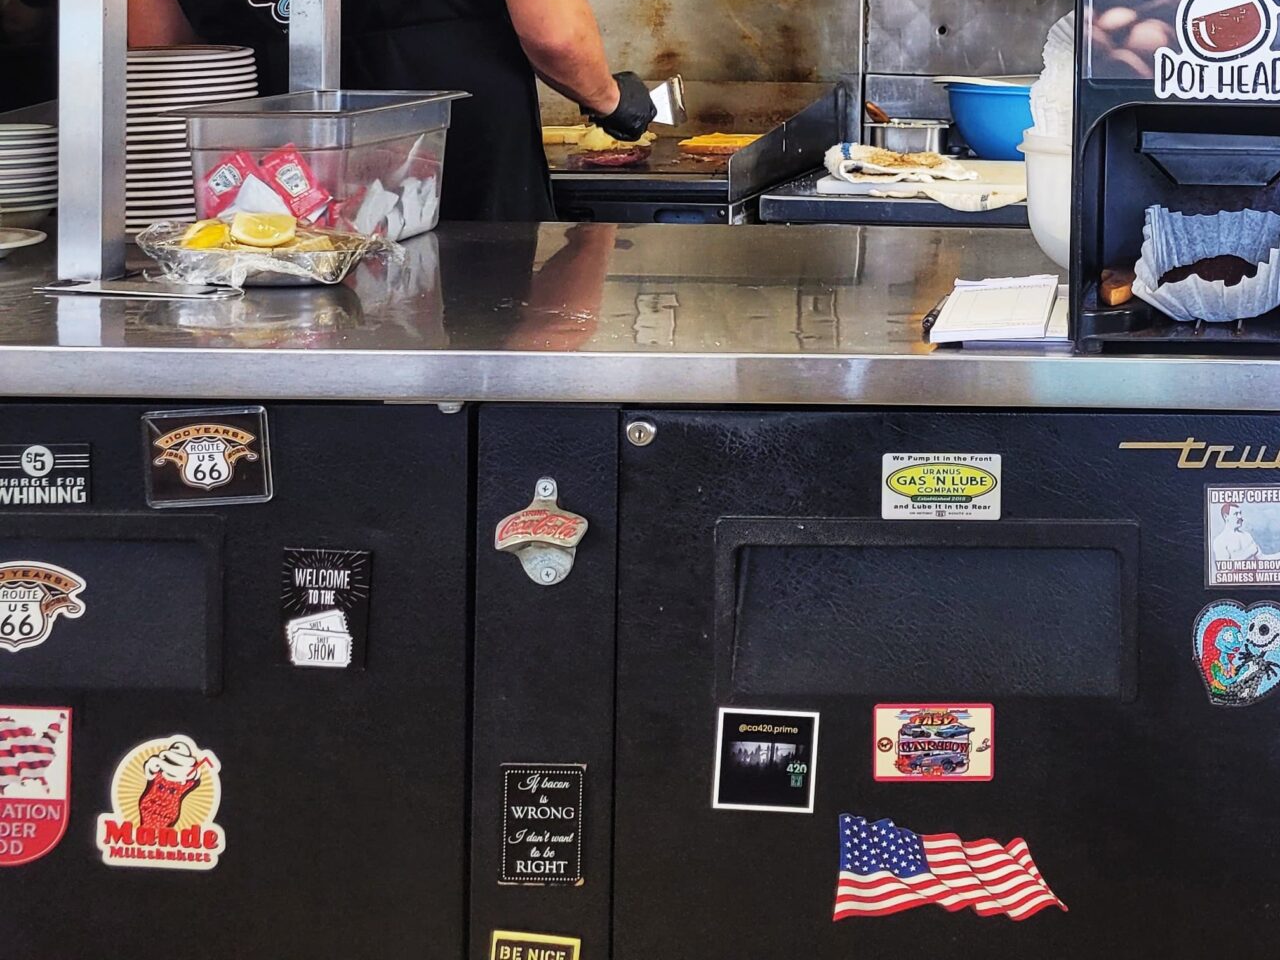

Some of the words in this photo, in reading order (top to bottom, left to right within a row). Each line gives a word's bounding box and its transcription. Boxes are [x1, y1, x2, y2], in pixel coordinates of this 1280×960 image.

[1161, 53, 1209, 93] POT
[194, 427, 240, 438] YEARS
[190, 442, 221, 452] ROUTE
[26, 452, 46, 471] $5
[193, 463, 223, 482] 66
[0, 478, 49, 486] HARGE
[57, 477, 85, 486] FOR
[896, 476, 926, 486] GAS
[932, 476, 946, 486] 'N
[951, 476, 988, 486] LUBE
[1211, 490, 1245, 503] DECAF
[1216, 560, 1233, 571] YOU
[1234, 560, 1257, 571] MEAN
[11, 570, 63, 585] YEARS
[295, 568, 351, 589] WELCOME
[1216, 572, 1254, 583] SADNESS
[2, 590, 39, 600] ROUTE
[308, 589, 318, 604] TO
[320, 590, 336, 605] THE
[0, 614, 34, 636] 66
[308, 643, 336, 660] SHOW
[915, 715, 956, 726] EASY
[738, 723, 799, 735] @ca420.prime
[786, 761, 807, 774] 420
[517, 774, 539, 793] If
[541, 777, 570, 789] bacon
[539, 794, 548, 804] is
[1, 804, 61, 820] ATION
[511, 806, 575, 819] WRONG
[0, 822, 36, 838] DER
[508, 829, 528, 845] I
[526, 830, 550, 843] don't
[551, 833, 574, 843] want
[530, 847, 541, 858] to
[543, 847, 555, 858] be
[516, 861, 568, 874] RIGHT
[500, 945, 523, 960] BE
[528, 947, 567, 960] NICE
